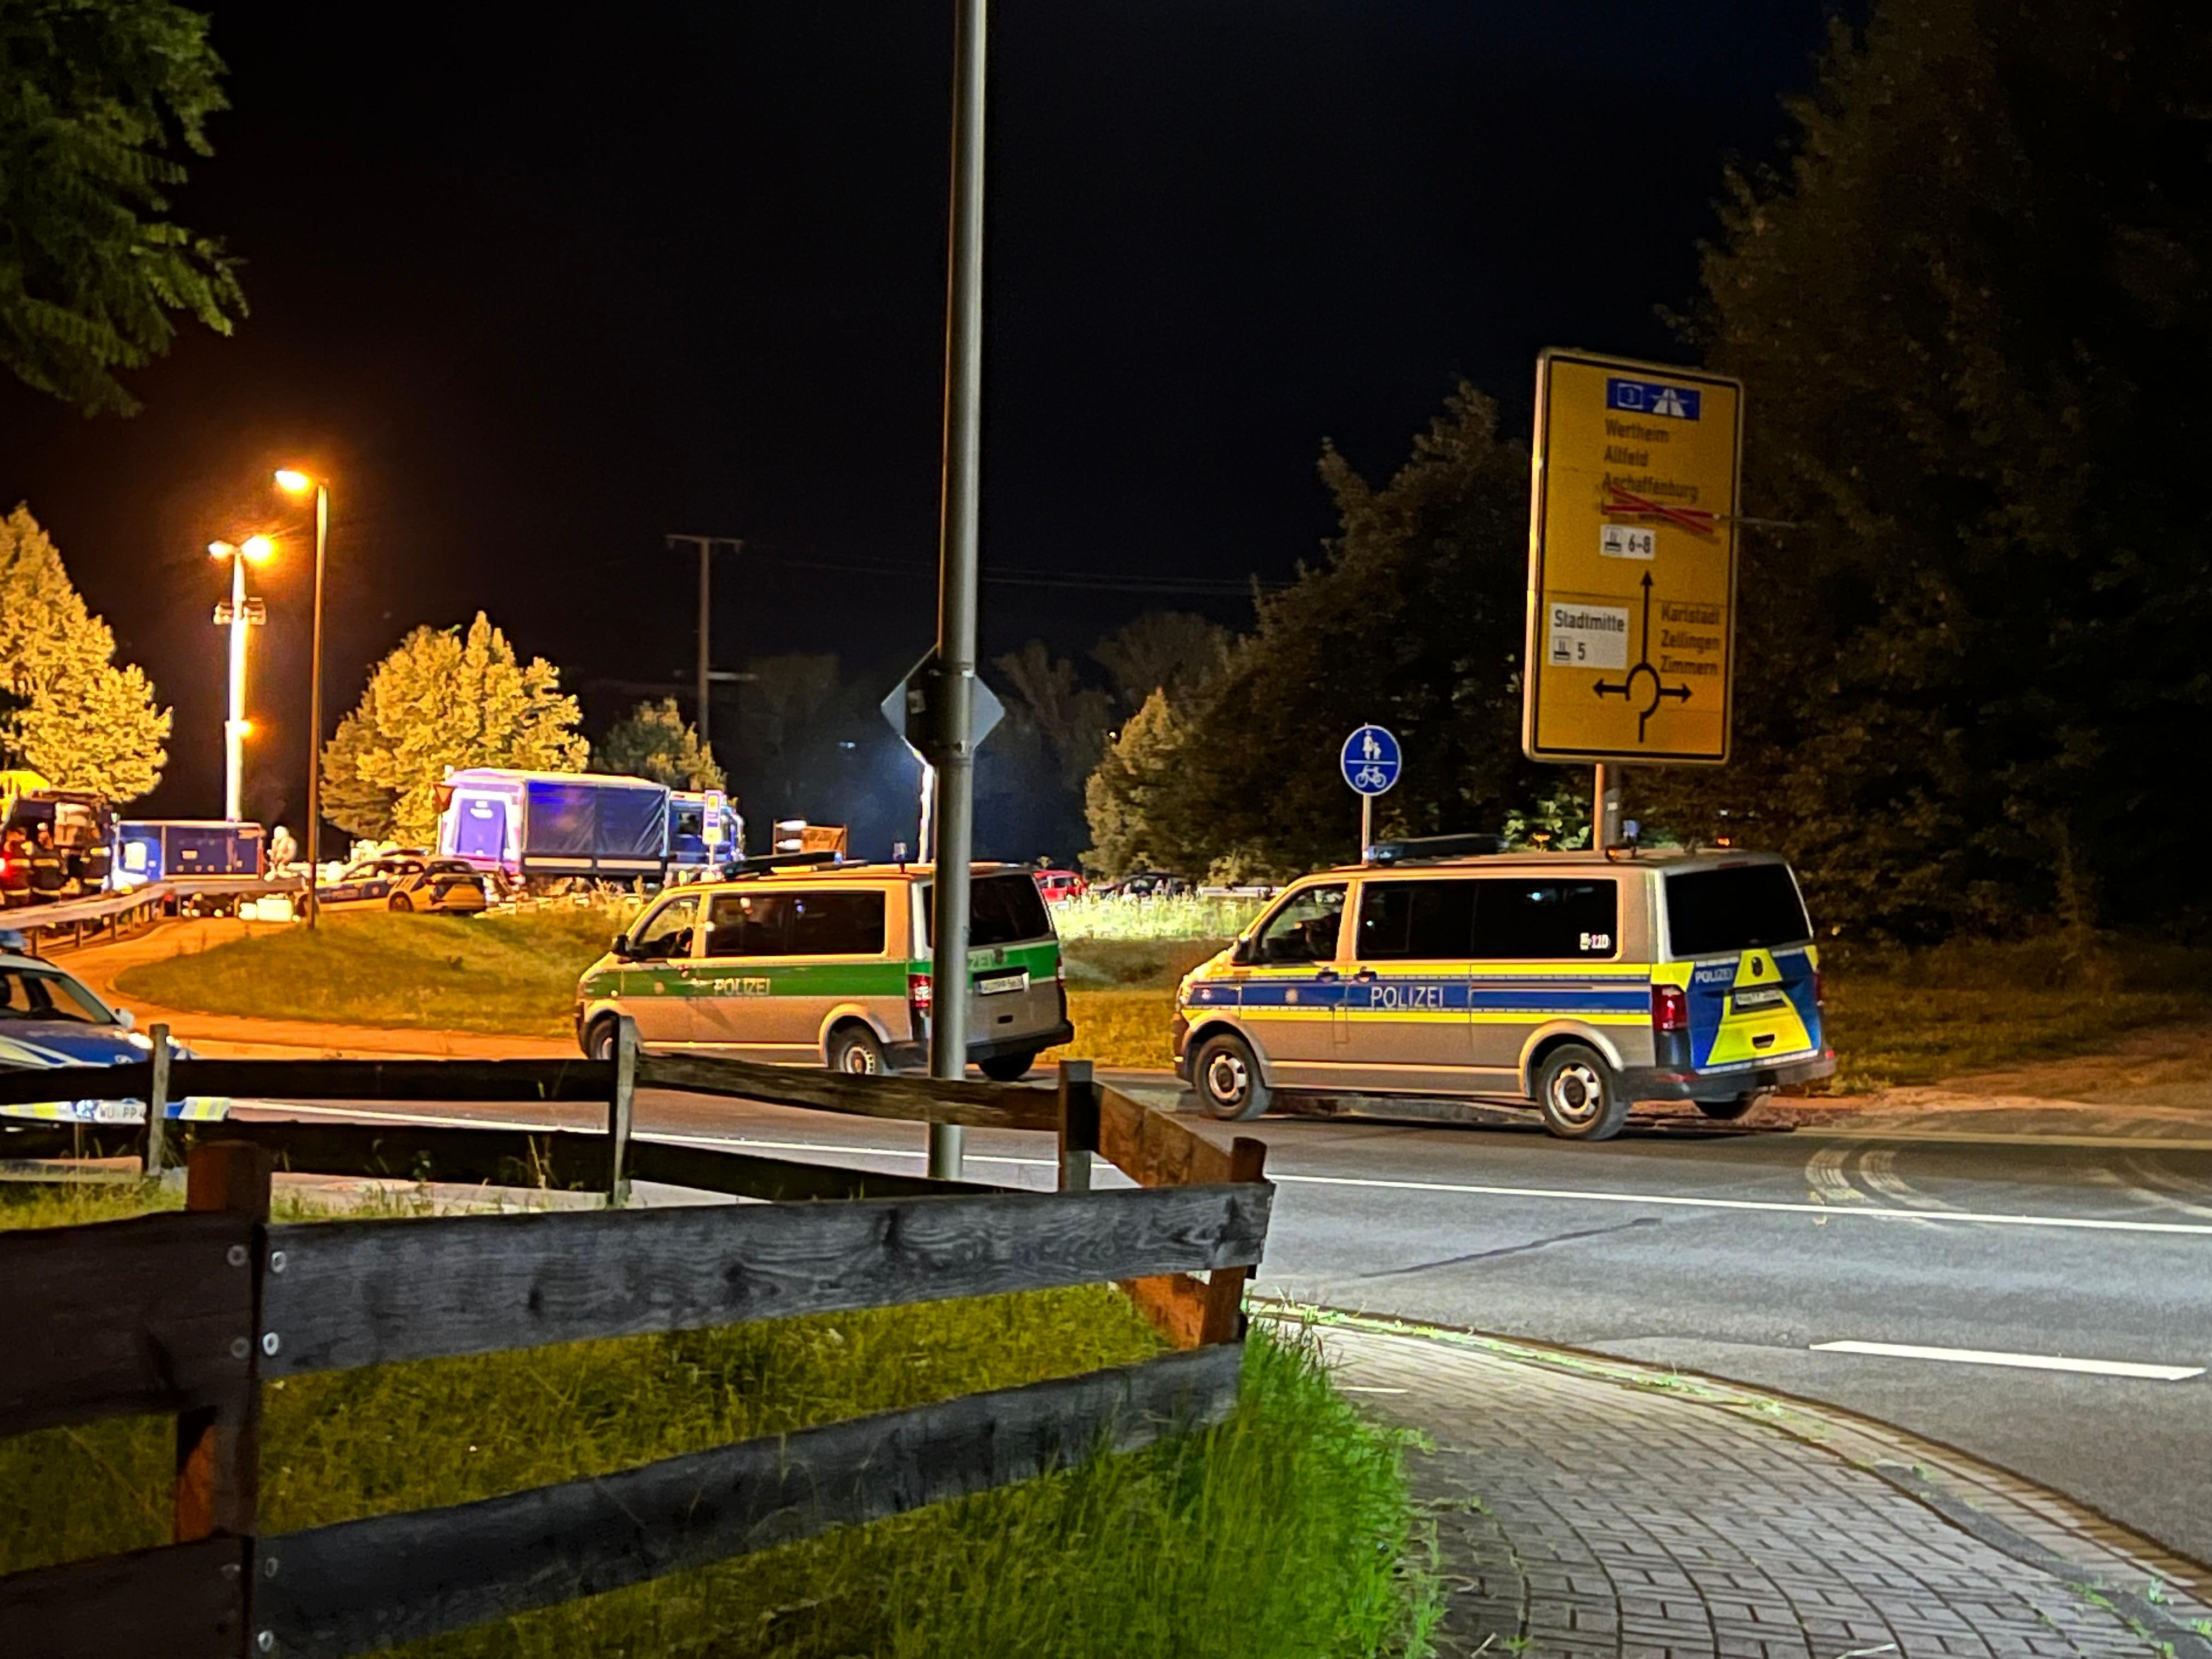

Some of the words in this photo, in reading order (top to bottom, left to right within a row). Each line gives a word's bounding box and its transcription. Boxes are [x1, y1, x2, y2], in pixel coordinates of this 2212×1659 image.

[1605, 417, 1669, 443] Wertheim
[1602, 472, 1700, 504] Aschaffenburg
[1628, 534, 1651, 554] 6-8
[1554, 609, 1625, 632] Stadtmitte
[1661, 602, 1720, 625] Karlstadt
[1577, 641, 1586, 661] 5
[1661, 629, 1720, 654] Zellingen
[1660, 654, 1718, 675] Zimmern
[713, 977, 770, 996] POLIZEI
[1695, 968, 1734, 984] POLIZEI
[1370, 986, 1444, 1008] POLIZEI
